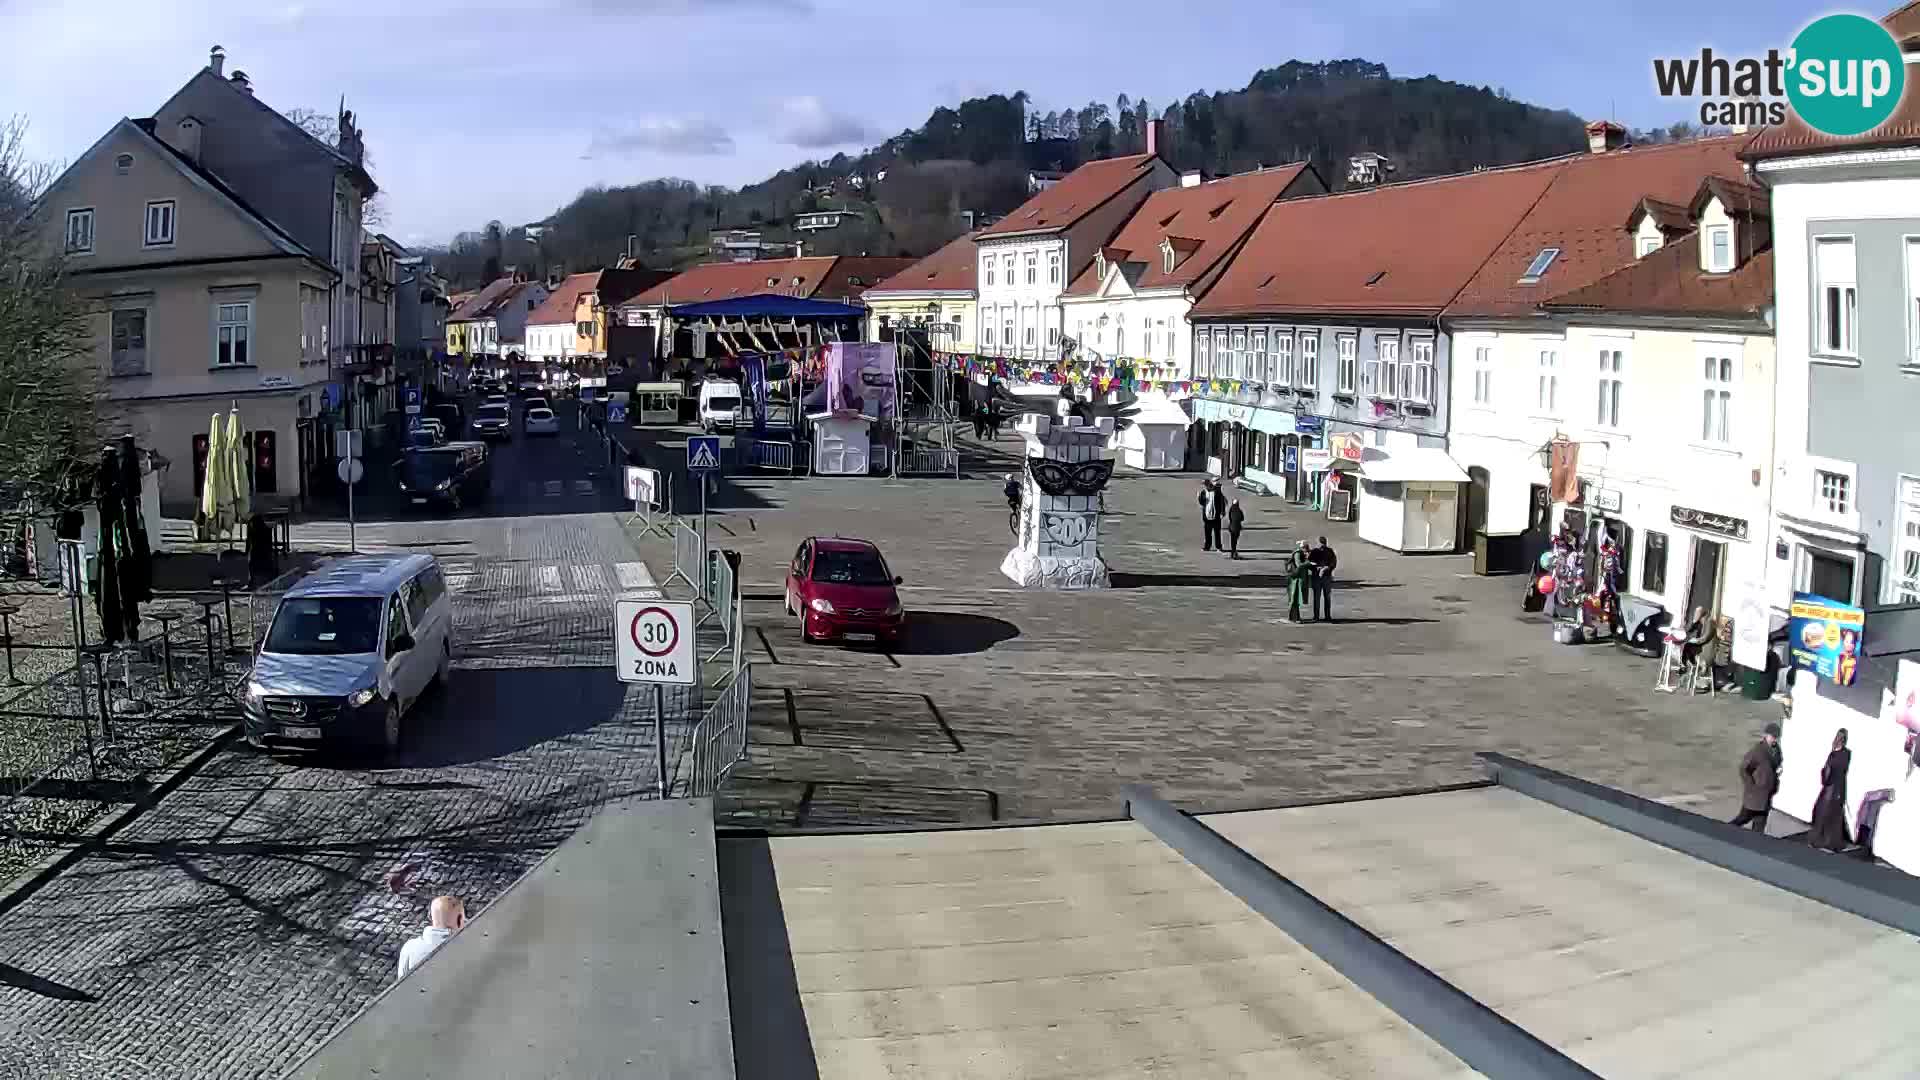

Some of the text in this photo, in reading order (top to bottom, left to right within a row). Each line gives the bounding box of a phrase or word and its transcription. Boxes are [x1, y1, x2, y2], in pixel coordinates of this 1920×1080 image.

[1047, 516, 1087, 546] 200
[643, 622, 668, 644] 30
[634, 660, 678, 676] ZONA
